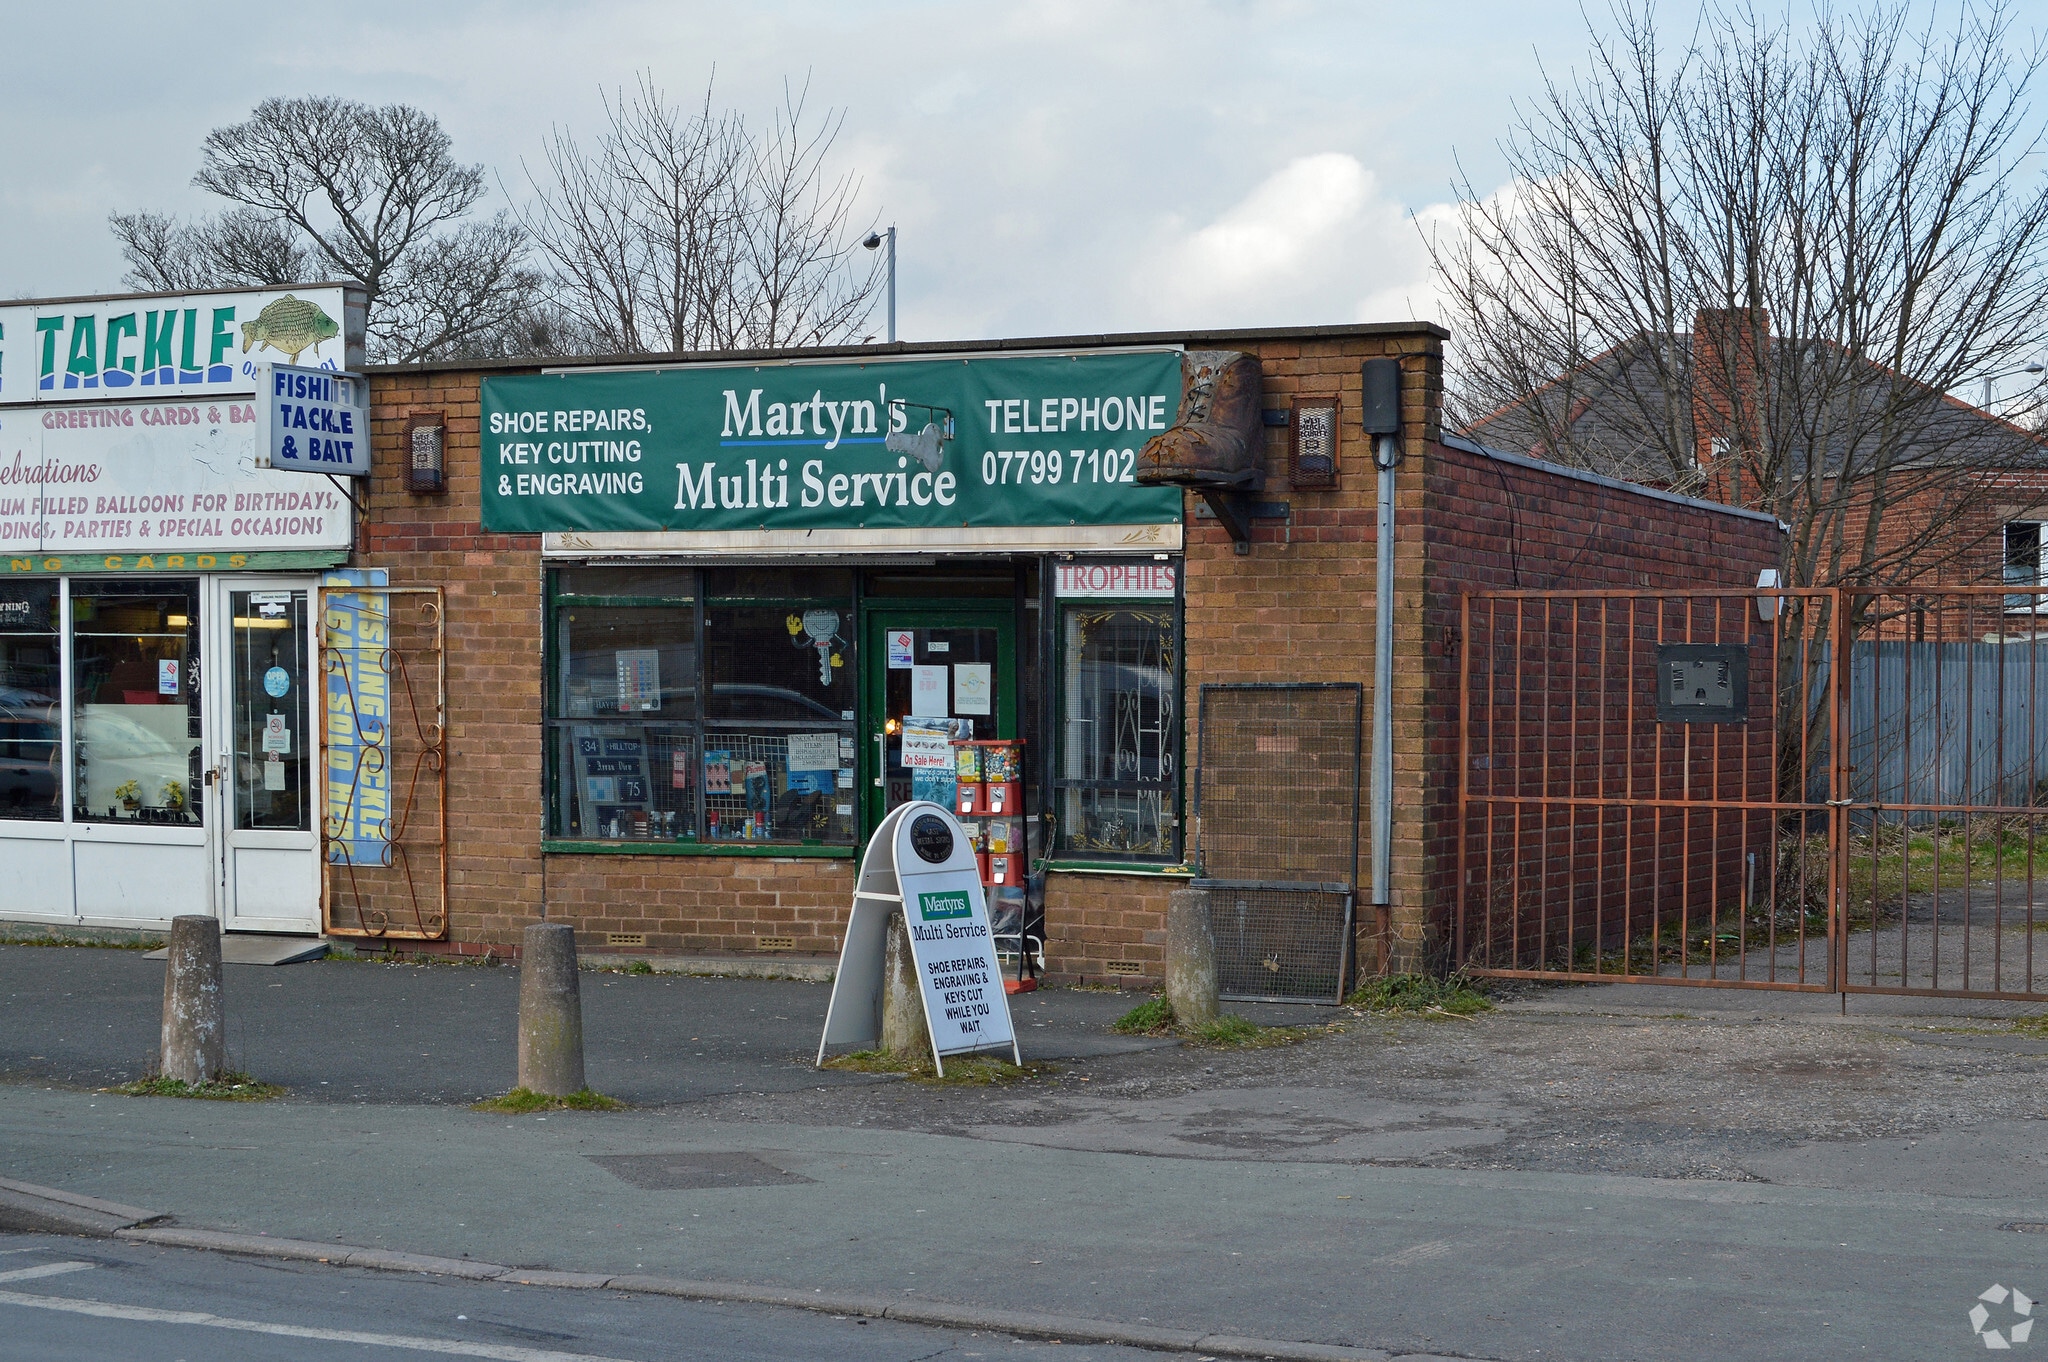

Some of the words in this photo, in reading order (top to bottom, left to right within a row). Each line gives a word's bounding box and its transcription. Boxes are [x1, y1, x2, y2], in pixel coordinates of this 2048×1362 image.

[36, 305, 236, 391] TACKLE
[275, 372, 334, 402] FISHI
[41, 408, 134, 431] GREETING
[140, 406, 200, 427] CARDS
[207, 405, 221, 424] &
[229, 404, 256, 424] BA
[489, 411, 548, 434] SHOE
[554, 408, 652, 434] REPAIRS,
[720, 382, 908, 451] Martyn's
[985, 395, 1167, 434] TELEPHONE
[281, 435, 299, 460] &
[309, 437, 354, 463] BAIT
[499, 443, 543, 465] KEY
[548, 440, 642, 463] CUTTING
[0, 450, 102, 485] ebrations
[982, 449, 1063, 485] 07799
[1070, 448, 1136, 484] 7102
[497, 474, 513, 496] &
[517, 472, 643, 496] ENGRAVING
[674, 458, 789, 510] Multi
[801, 456, 957, 508] Service
[0, 497, 25, 516] UM
[31, 496, 89, 515] FILLED
[95, 494, 184, 514] BALLOONS
[192, 493, 226, 513] FOR
[234, 491, 340, 513] BIRTHDAYS,
[0, 519, 56, 540] DINGS,
[63, 518, 132, 539] PARTIES
[139, 517, 152, 538] &
[158, 517, 224, 537] SPECIAL
[231, 516, 324, 536] OCCASIONS
[11, 556, 63, 573] NG
[104, 554, 249, 570] CARDS
[1059, 564, 1176, 592] TROPHIES
[327, 609, 353, 682] BAIT
[357, 592, 385, 717] FISHING
[327, 692, 354, 772] SOLD
[584, 740, 596, 752] 34
[609, 742, 638, 751] HILLTOP
[904, 754, 913, 765] On
[914, 754, 927, 766] Sale
[929, 755, 945, 767] Here!
[358, 730, 386, 841] TACKLE
[626, 781, 641, 797] 75
[891, 782, 912, 800] RE
[940, 776, 955, 784] supp
[328, 780, 355, 856] HERE
[924, 894, 966, 914] Martyns
[913, 923, 944, 942] Multi
[946, 922, 987, 940] Service
[928, 961, 950, 975] SHOE
[951, 956, 989, 972] REPAIRS,
[933, 975, 981, 990] ENGRAVING
[982, 972, 989, 983] &
[944, 990, 967, 1004] KEYS
[967, 988, 983, 1002] CUT
[945, 1006, 972, 1020] WHILE
[972, 1003, 990, 1016] YOU
[960, 1020, 981, 1034] WAIT
